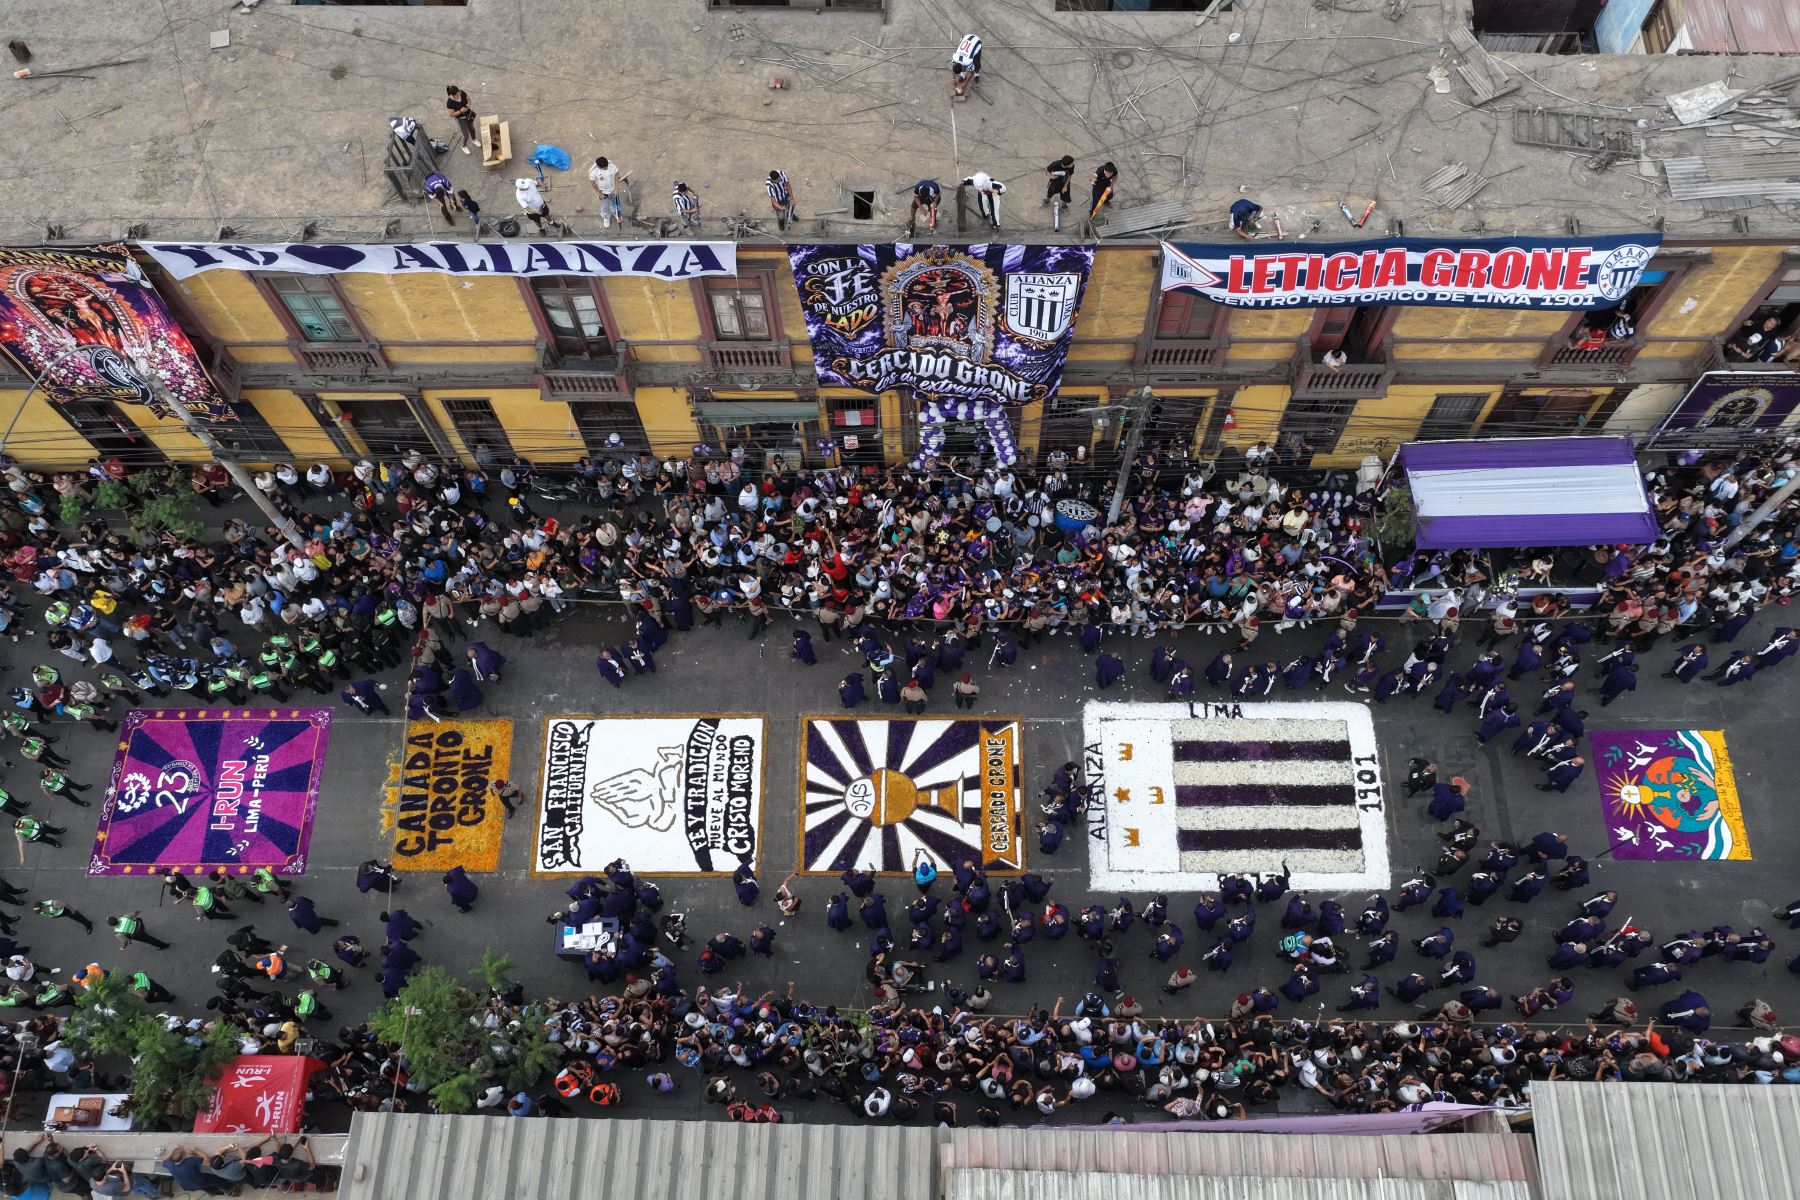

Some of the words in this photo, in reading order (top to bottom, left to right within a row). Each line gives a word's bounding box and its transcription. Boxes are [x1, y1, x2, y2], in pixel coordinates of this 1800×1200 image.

[394, 243, 726, 274] ALIANZA
[807, 260, 840, 276] CON
[846, 259, 870, 269] LA
[1227, 248, 1407, 294] LETICIA
[1420, 247, 1593, 290] GRONE
[1015, 275, 1073, 285] ALIANZA
[1209, 293, 1302, 307] CENTRO
[1308, 289, 1428, 304] HISTORICO
[1435, 291, 1465, 303] DE
[1472, 291, 1533, 305] LIMA
[1540, 293, 1596, 306] 1901
[814, 302, 828, 312] DE
[831, 293, 879, 316] NUESTRO
[825, 304, 878, 332] LADO
[1009, 293, 1019, 317] CLUB
[1063, 297, 1074, 321] LIMA
[1029, 328, 1048, 340] 1901
[850, 350, 953, 380] CERCADO
[955, 362, 1035, 401] GRONE
[919, 379, 1007, 402] extranjero
[1189, 703, 1243, 719] LIMA
[548, 722, 574, 810] FRANCISCO
[688, 720, 716, 812] TRADICION
[712, 734, 727, 783] MUNDO
[730, 738, 751, 792] MORENO
[987, 737, 1007, 786] GRONE
[156, 771, 189, 814] 23
[211, 760, 247, 830] I-RUN
[396, 732, 434, 857] CANADA
[427, 731, 464, 851] TORONTO
[457, 745, 493, 826] GRONE
[566, 747, 587, 836] CALIFORNIA
[712, 788, 724, 806] AL
[1086, 741, 1106, 841] ALIANZA
[1355, 754, 1383, 813] 1901
[689, 815, 706, 829] Y
[689, 830, 708, 851] FE
[710, 807, 724, 849] MUEVE
[727, 797, 752, 854] CRISTO
[990, 790, 1009, 852] CERCADO
[543, 826, 564, 868] SAN
[235, 1067, 272, 1075] I-RUN
[271, 1091, 285, 1129] I-RUN
